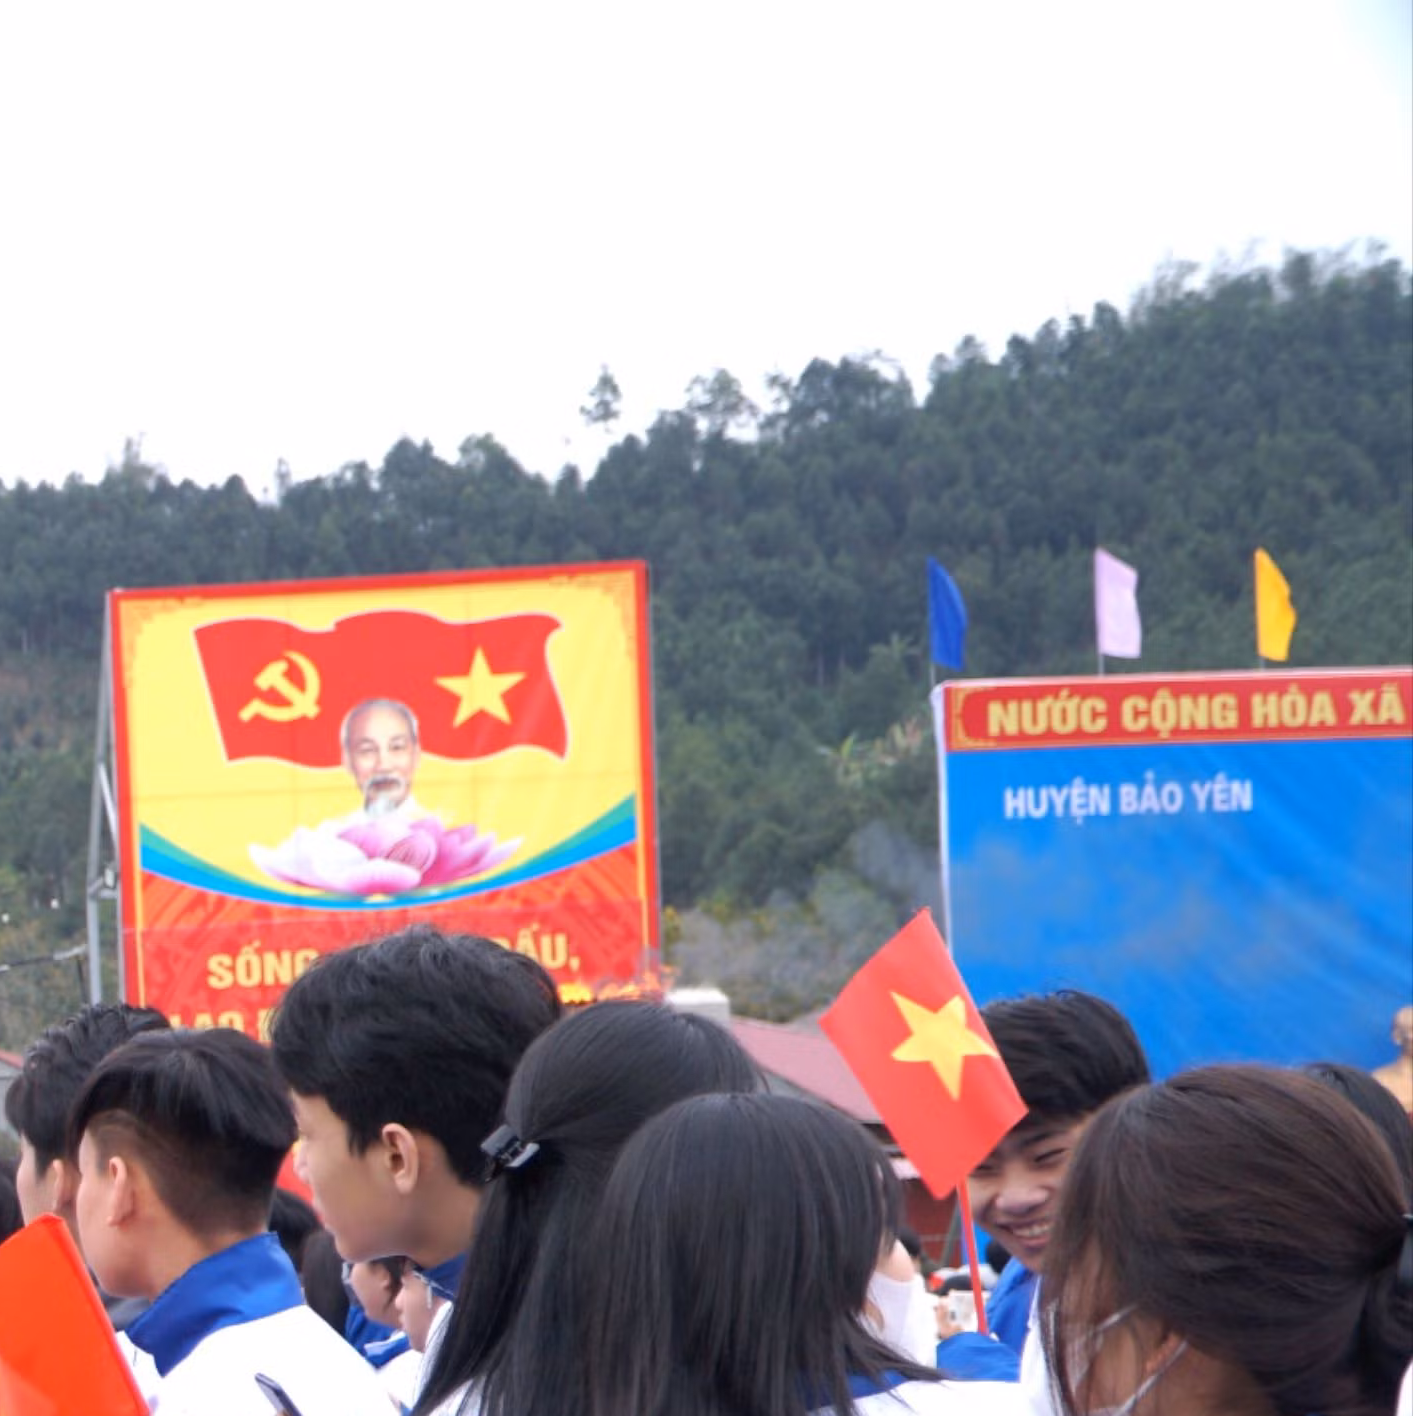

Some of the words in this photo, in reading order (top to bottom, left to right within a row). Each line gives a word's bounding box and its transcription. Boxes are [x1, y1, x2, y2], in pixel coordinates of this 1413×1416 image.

[987, 688, 1108, 737] NƯỚC
[1121, 688, 1239, 738] CỘNG
[1251, 684, 1337, 727] HÒA
[1348, 684, 1406, 726] XÃ
[1003, 776, 1111, 824] HUYỆN
[1118, 771, 1183, 815] BẢO
[1191, 771, 1254, 813] YÊN
